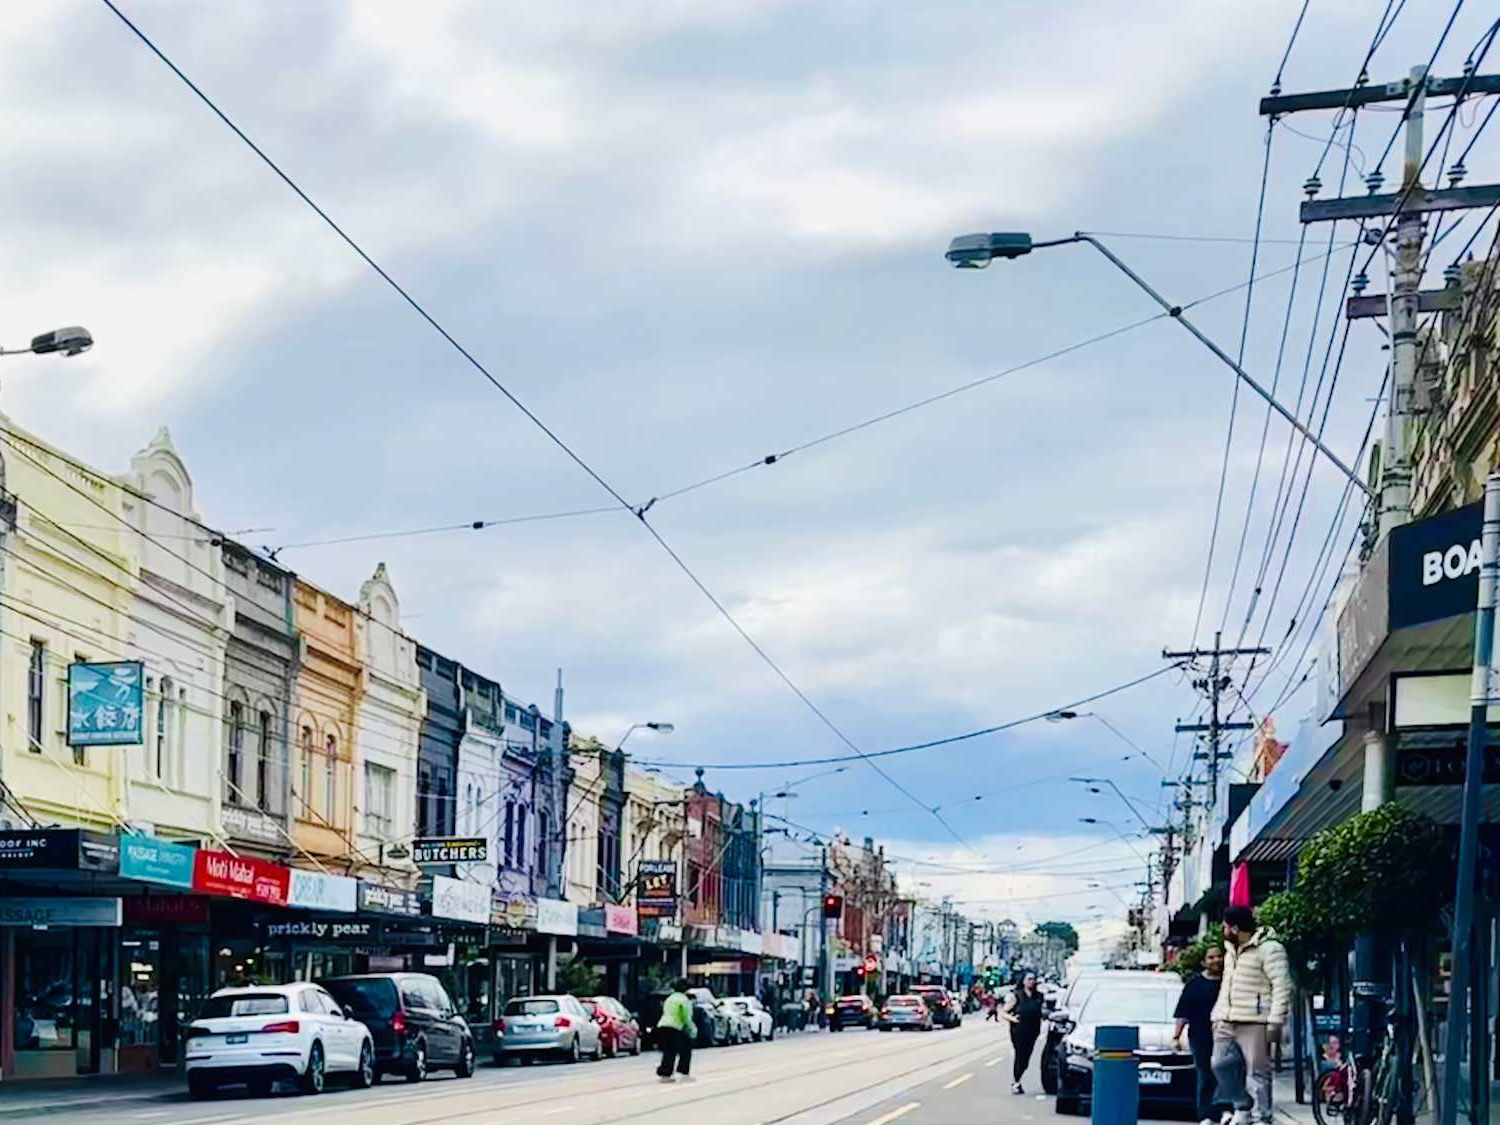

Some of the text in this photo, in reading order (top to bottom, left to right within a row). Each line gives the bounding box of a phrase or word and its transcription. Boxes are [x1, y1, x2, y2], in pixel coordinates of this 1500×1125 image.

[26, 838, 47, 848] INC
[413, 846, 487, 862] BUTCHERS
[206, 855, 229, 880] Moti
[229, 860, 255, 885] Mahal
[267, 922, 370, 937] prickly pear
